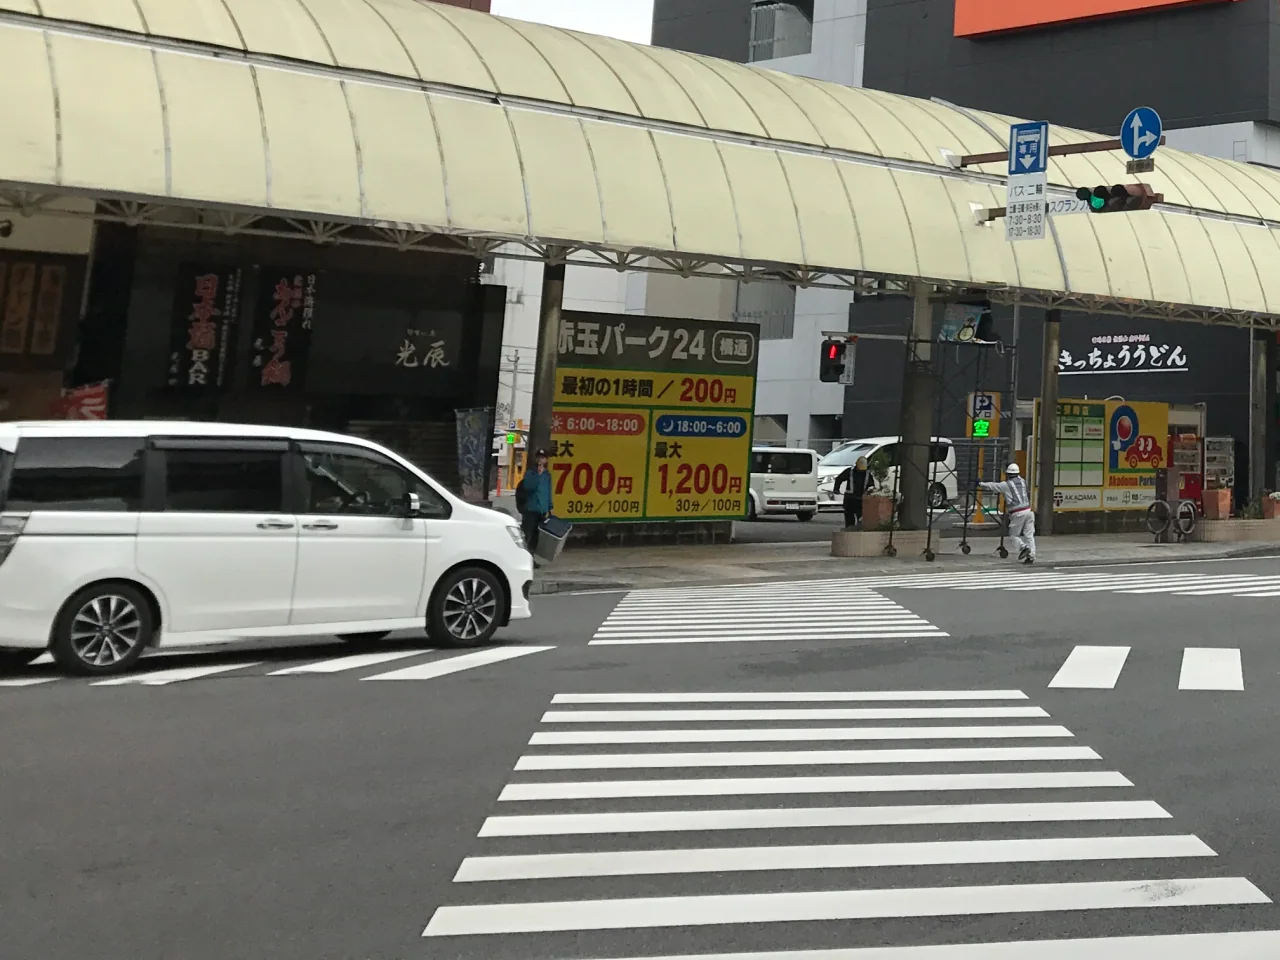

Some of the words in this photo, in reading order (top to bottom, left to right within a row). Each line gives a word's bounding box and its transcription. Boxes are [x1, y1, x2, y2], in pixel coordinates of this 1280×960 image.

[1018, 143, 1037, 154] 専用
[1009, 214, 1042, 226] 7:30-8:30
[395, 339, 450, 369] 光辰
[1058, 344, 1187, 370] きっちょううどん
[680, 377, 737, 404] 200円
[567, 417, 639, 432] 6:00~18:00
[677, 419, 742, 434] 18:00~6:00
[973, 419, 990, 437] 空
[654, 441, 683, 459] 最大
[553, 462, 633, 496] 700円
[658, 462, 742, 499] 1,200円
[566, 499, 640, 514] 30分/100円
[675, 499, 741, 513] 30分/100円
